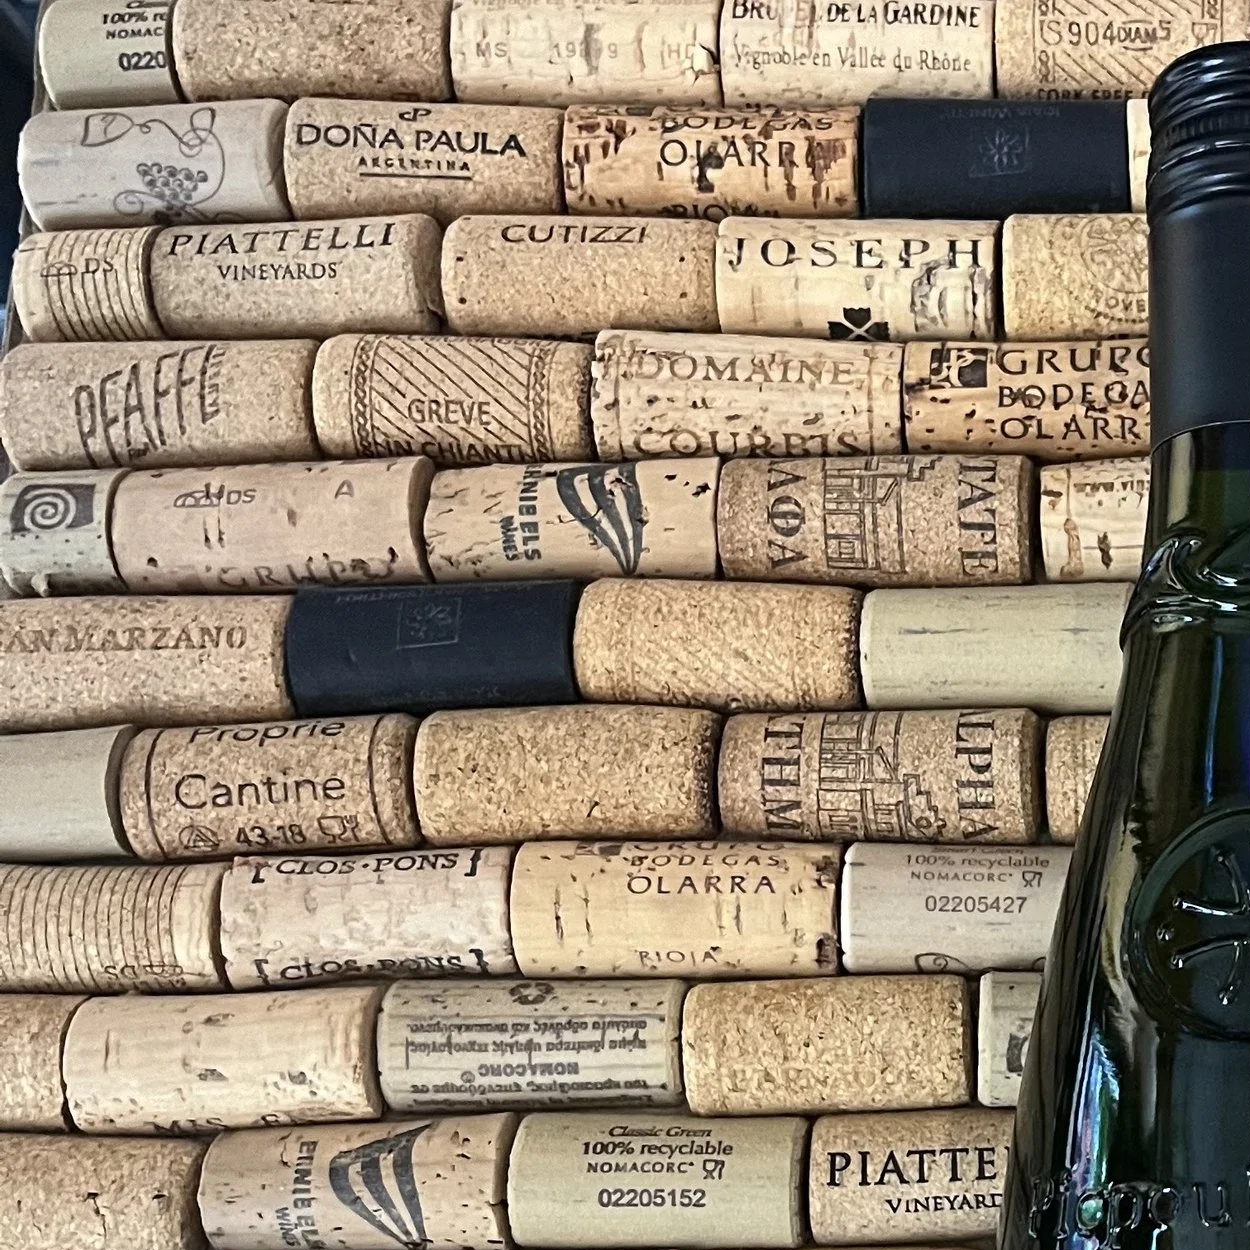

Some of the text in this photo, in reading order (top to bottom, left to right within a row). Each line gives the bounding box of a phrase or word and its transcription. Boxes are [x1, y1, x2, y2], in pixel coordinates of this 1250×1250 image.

[884, 1, 981, 28] GARDINE
[118, 52, 166, 71] 0220
[296, 122, 526, 158] DOÑA PAULA
[358, 156, 471, 173] ARGENTINA
[168, 222, 398, 257] PIATTELLI
[500, 225, 647, 245] CUTIZZI
[727, 238, 983, 270] JOSEPH
[217, 260, 341, 281] VINEYARDS
[633, 352, 853, 386] DOMAINE
[999, 387, 1149, 411] BODEGA
[409, 399, 492, 427] GREVE
[1000, 416, 1143, 441] OLARR
[957, 459, 999, 577] TATE
[64, 624, 248, 652] MARZANO
[175, 774, 346, 810] Cantine
[630, 854, 781, 868] BODEGAS
[906, 854, 1050, 871] 100% recyclable
[627, 874, 776, 896] OLARRA
[924, 895, 1027, 914] 02205427
[581, 1139, 734, 1157] 100% recyclable
[826, 1146, 1010, 1187] PIATTE
[597, 1188, 706, 1209] 02205152
